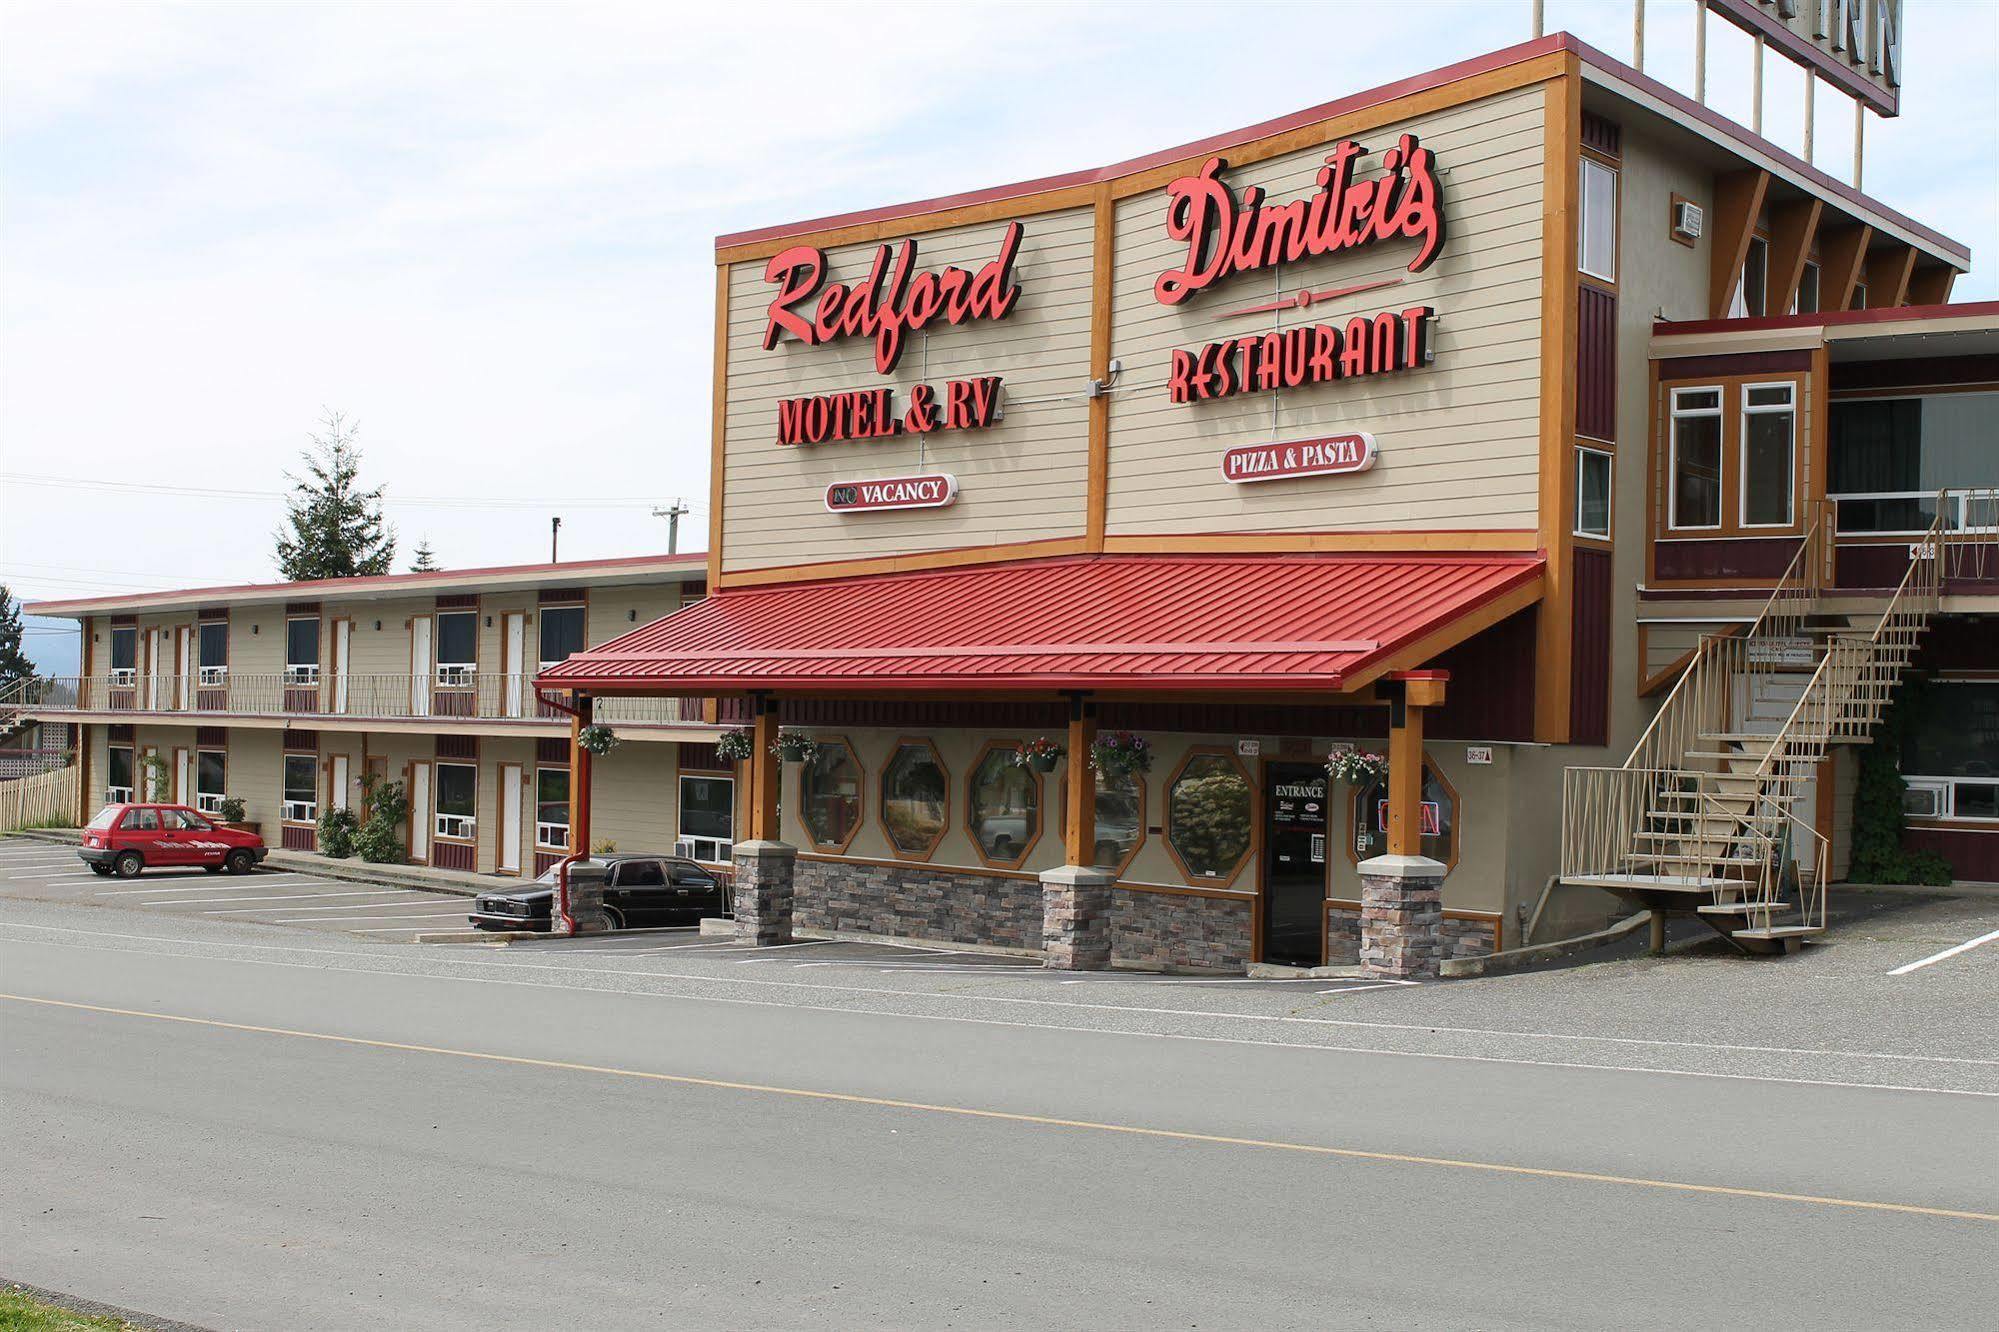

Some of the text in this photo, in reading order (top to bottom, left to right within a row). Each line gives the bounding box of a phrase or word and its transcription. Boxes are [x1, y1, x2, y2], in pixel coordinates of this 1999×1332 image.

[1155, 133, 1446, 305] Dimitri's
[762, 220, 1024, 375] Redford
[1167, 306, 1434, 403] RESTAURANT
[776, 376, 1003, 445] MOTEL & RV
[1229, 440, 1359, 475] PIZZA & PASTA
[833, 480, 943, 505] NO VACANCY
[1275, 784, 1324, 798] ENTRANCE
